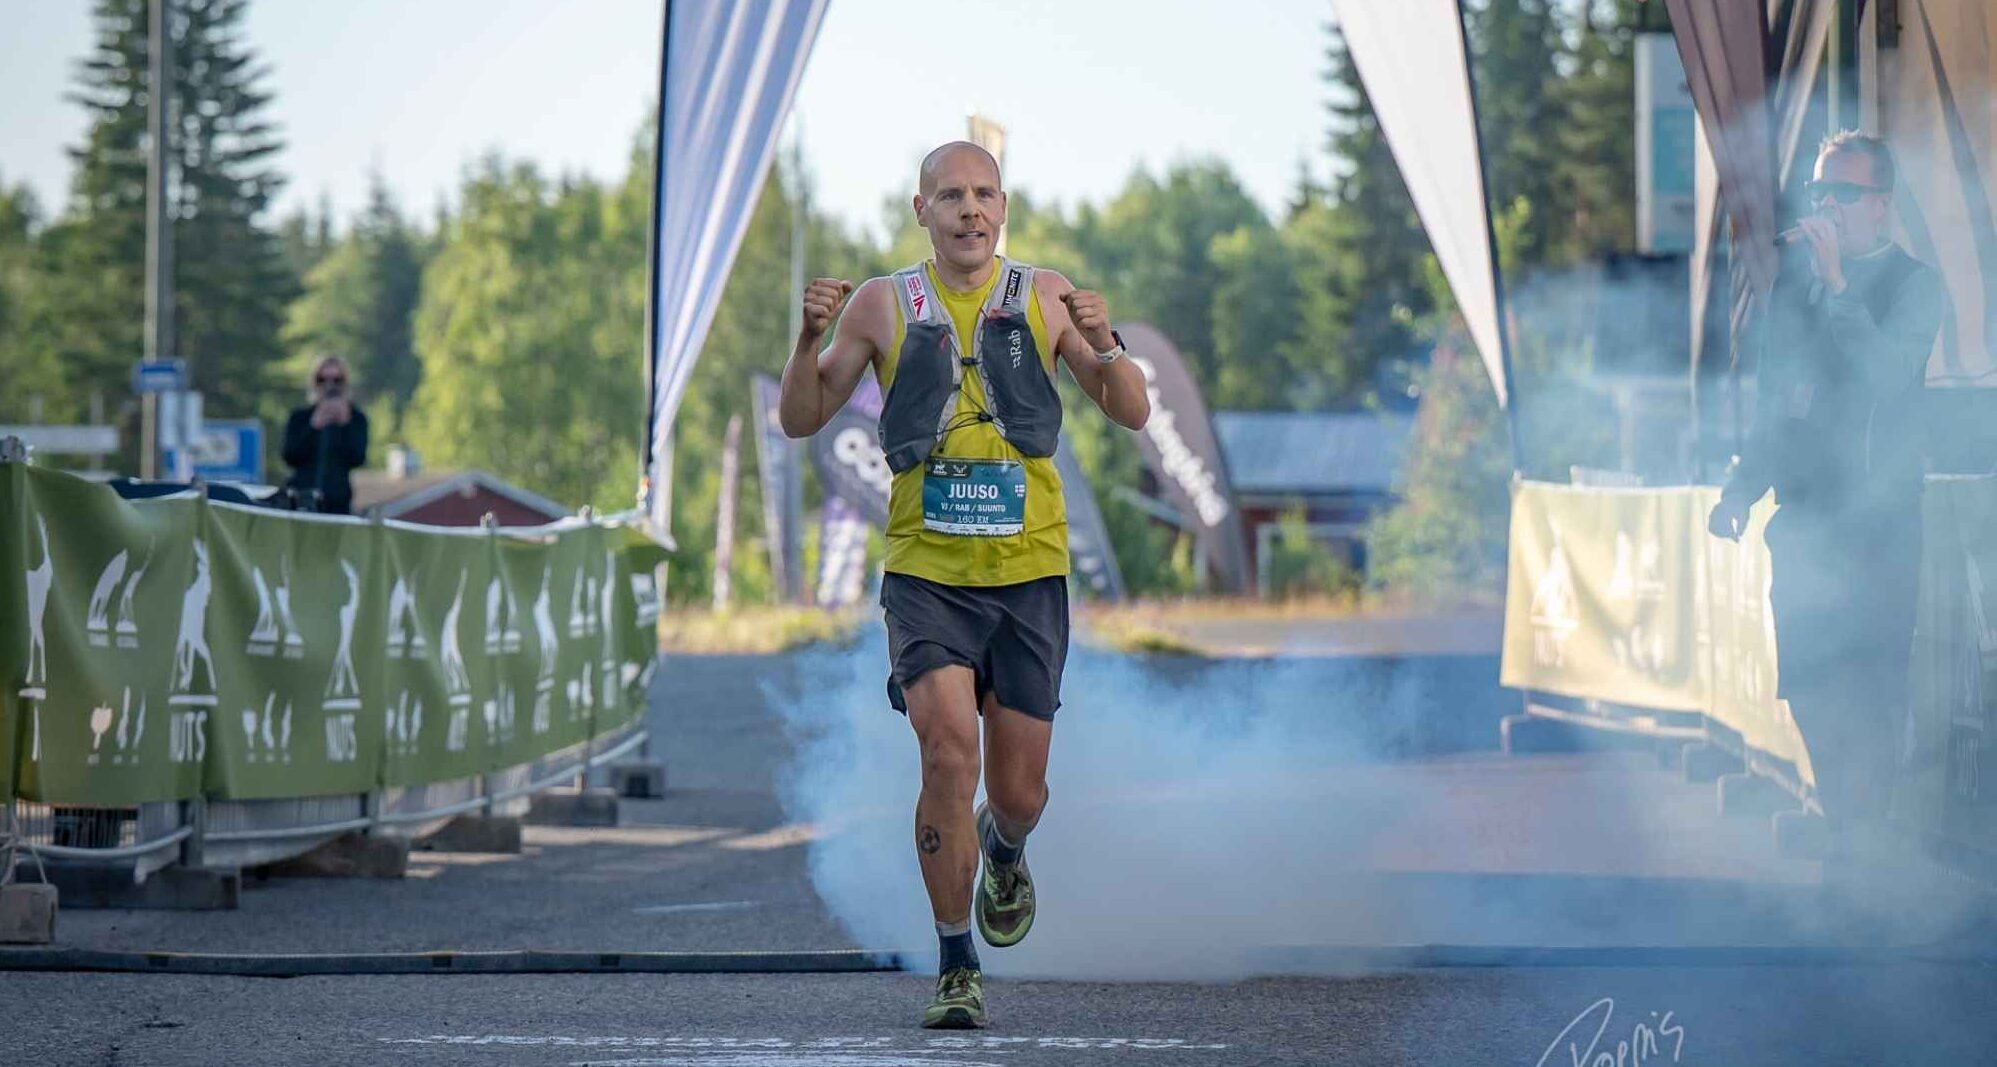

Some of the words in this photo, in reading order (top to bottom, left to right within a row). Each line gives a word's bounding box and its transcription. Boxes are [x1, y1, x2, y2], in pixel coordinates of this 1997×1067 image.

[1008, 329, 1021, 356] Rab
[948, 483, 998, 500] JUUSO
[955, 503, 970, 511] RAB
[978, 504, 1006, 512] SUUNTO
